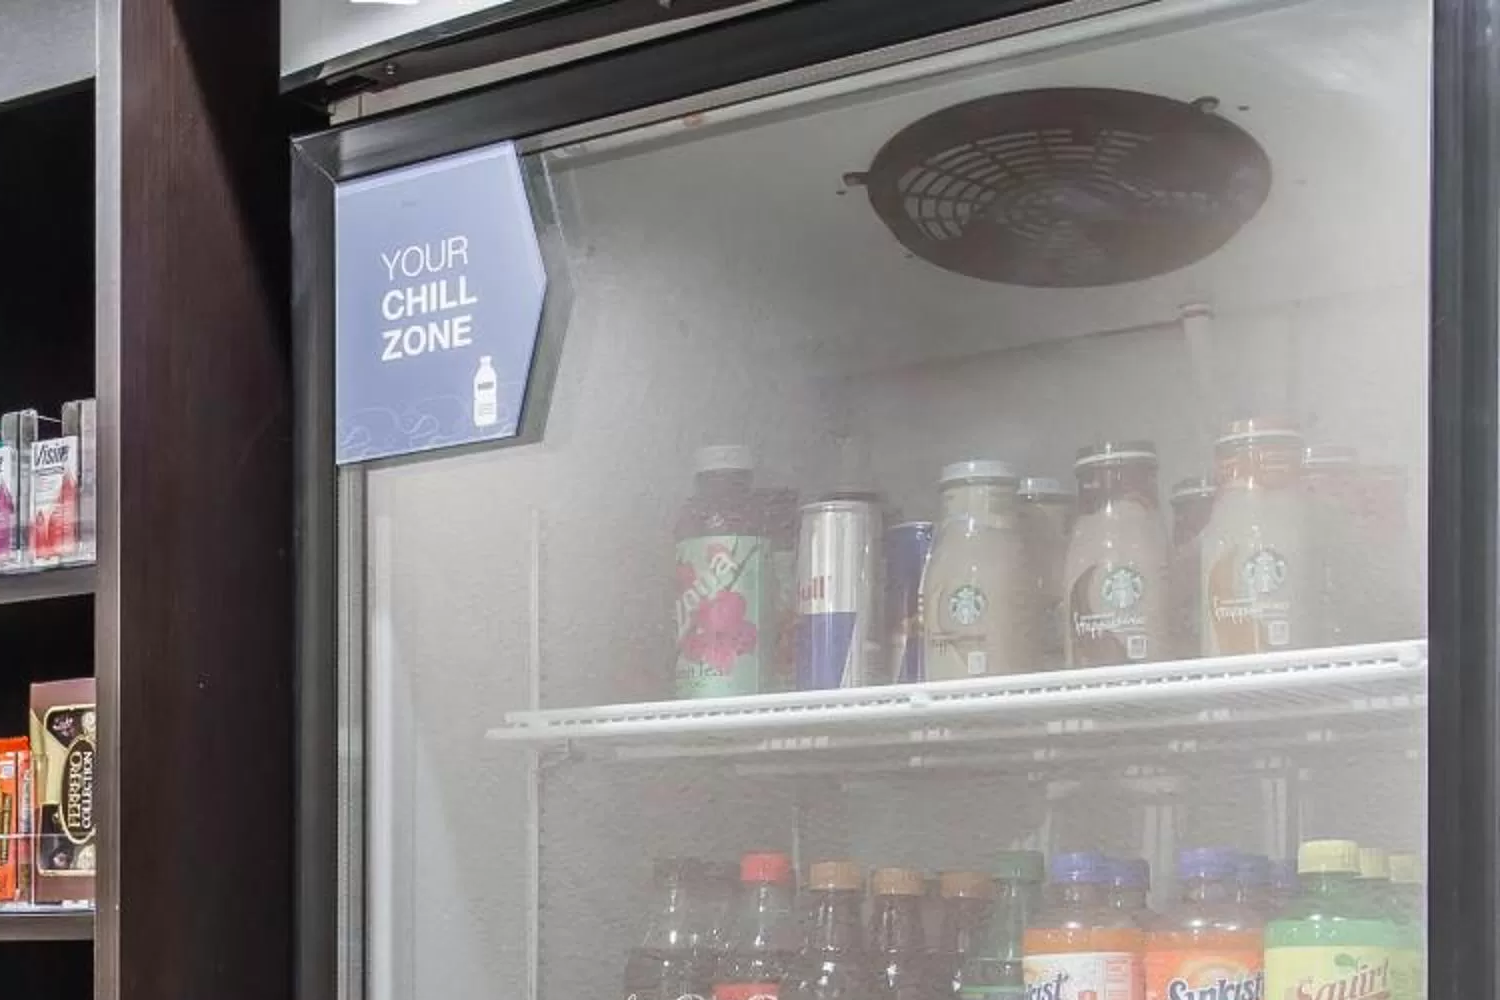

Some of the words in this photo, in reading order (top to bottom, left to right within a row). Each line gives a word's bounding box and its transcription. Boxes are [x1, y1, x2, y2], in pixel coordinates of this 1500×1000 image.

[380, 234, 469, 281] YOUR
[381, 275, 478, 321] CHILL
[381, 315, 473, 361] ZONE
